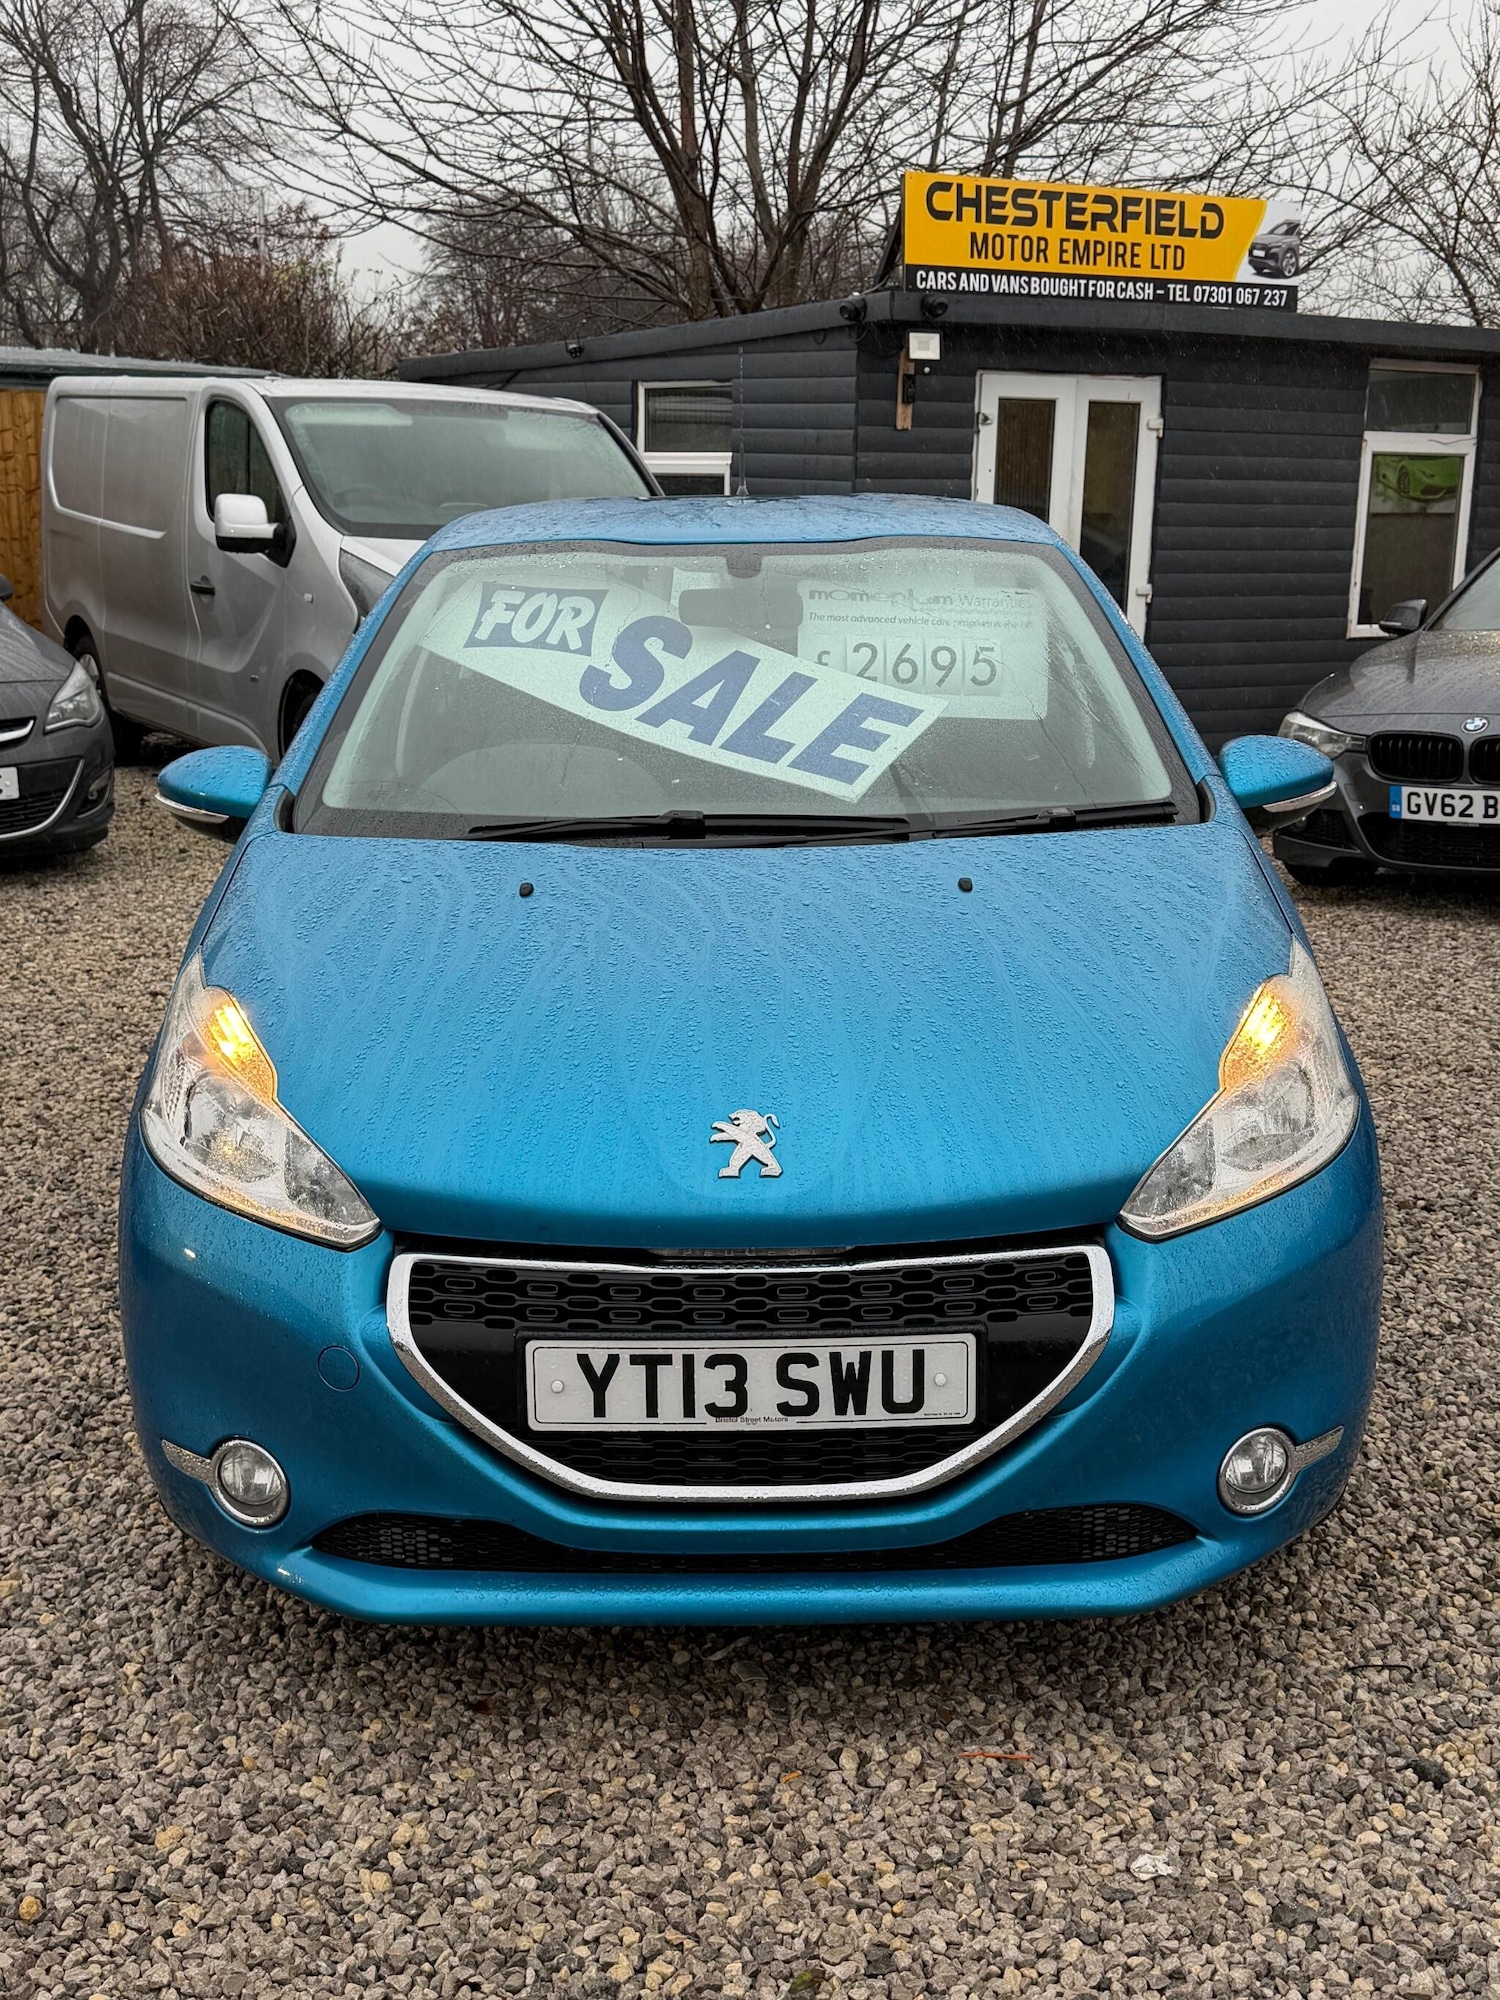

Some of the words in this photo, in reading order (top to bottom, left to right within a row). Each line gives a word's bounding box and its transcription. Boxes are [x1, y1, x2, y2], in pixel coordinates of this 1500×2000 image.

[926, 181, 1224, 239] CHESTERFIELD
[970, 231, 1049, 264] MOTOR
[1058, 237, 1142, 269] EMPIRE
[1150, 243, 1185, 271] LTD
[916, 270, 956, 291] CARS
[958, 272, 990, 293] AND
[990, 274, 1031, 295] VANS
[1030, 277, 1088, 298] BOUGHT
[1088, 281, 1115, 299] FOR
[1116, 281, 1154, 301] CASH
[1167, 284, 1191, 303] TEL
[1193, 285, 1232, 305] 07301
[1235, 288, 1260, 306] 067
[1263, 290, 1288, 307] 237
[474, 589, 596, 651] FOR
[808, 611, 825, 622] The
[826, 613, 849, 623] most
[850, 614, 897, 625] advanced
[898, 616, 930, 626] vehicle
[578, 615, 925, 786] SALE
[1407, 791, 1474, 818] GV62
[1483, 795, 1498, 819] B
[576, 1352, 749, 1418] YT13
[776, 1348, 926, 1417] SWU
